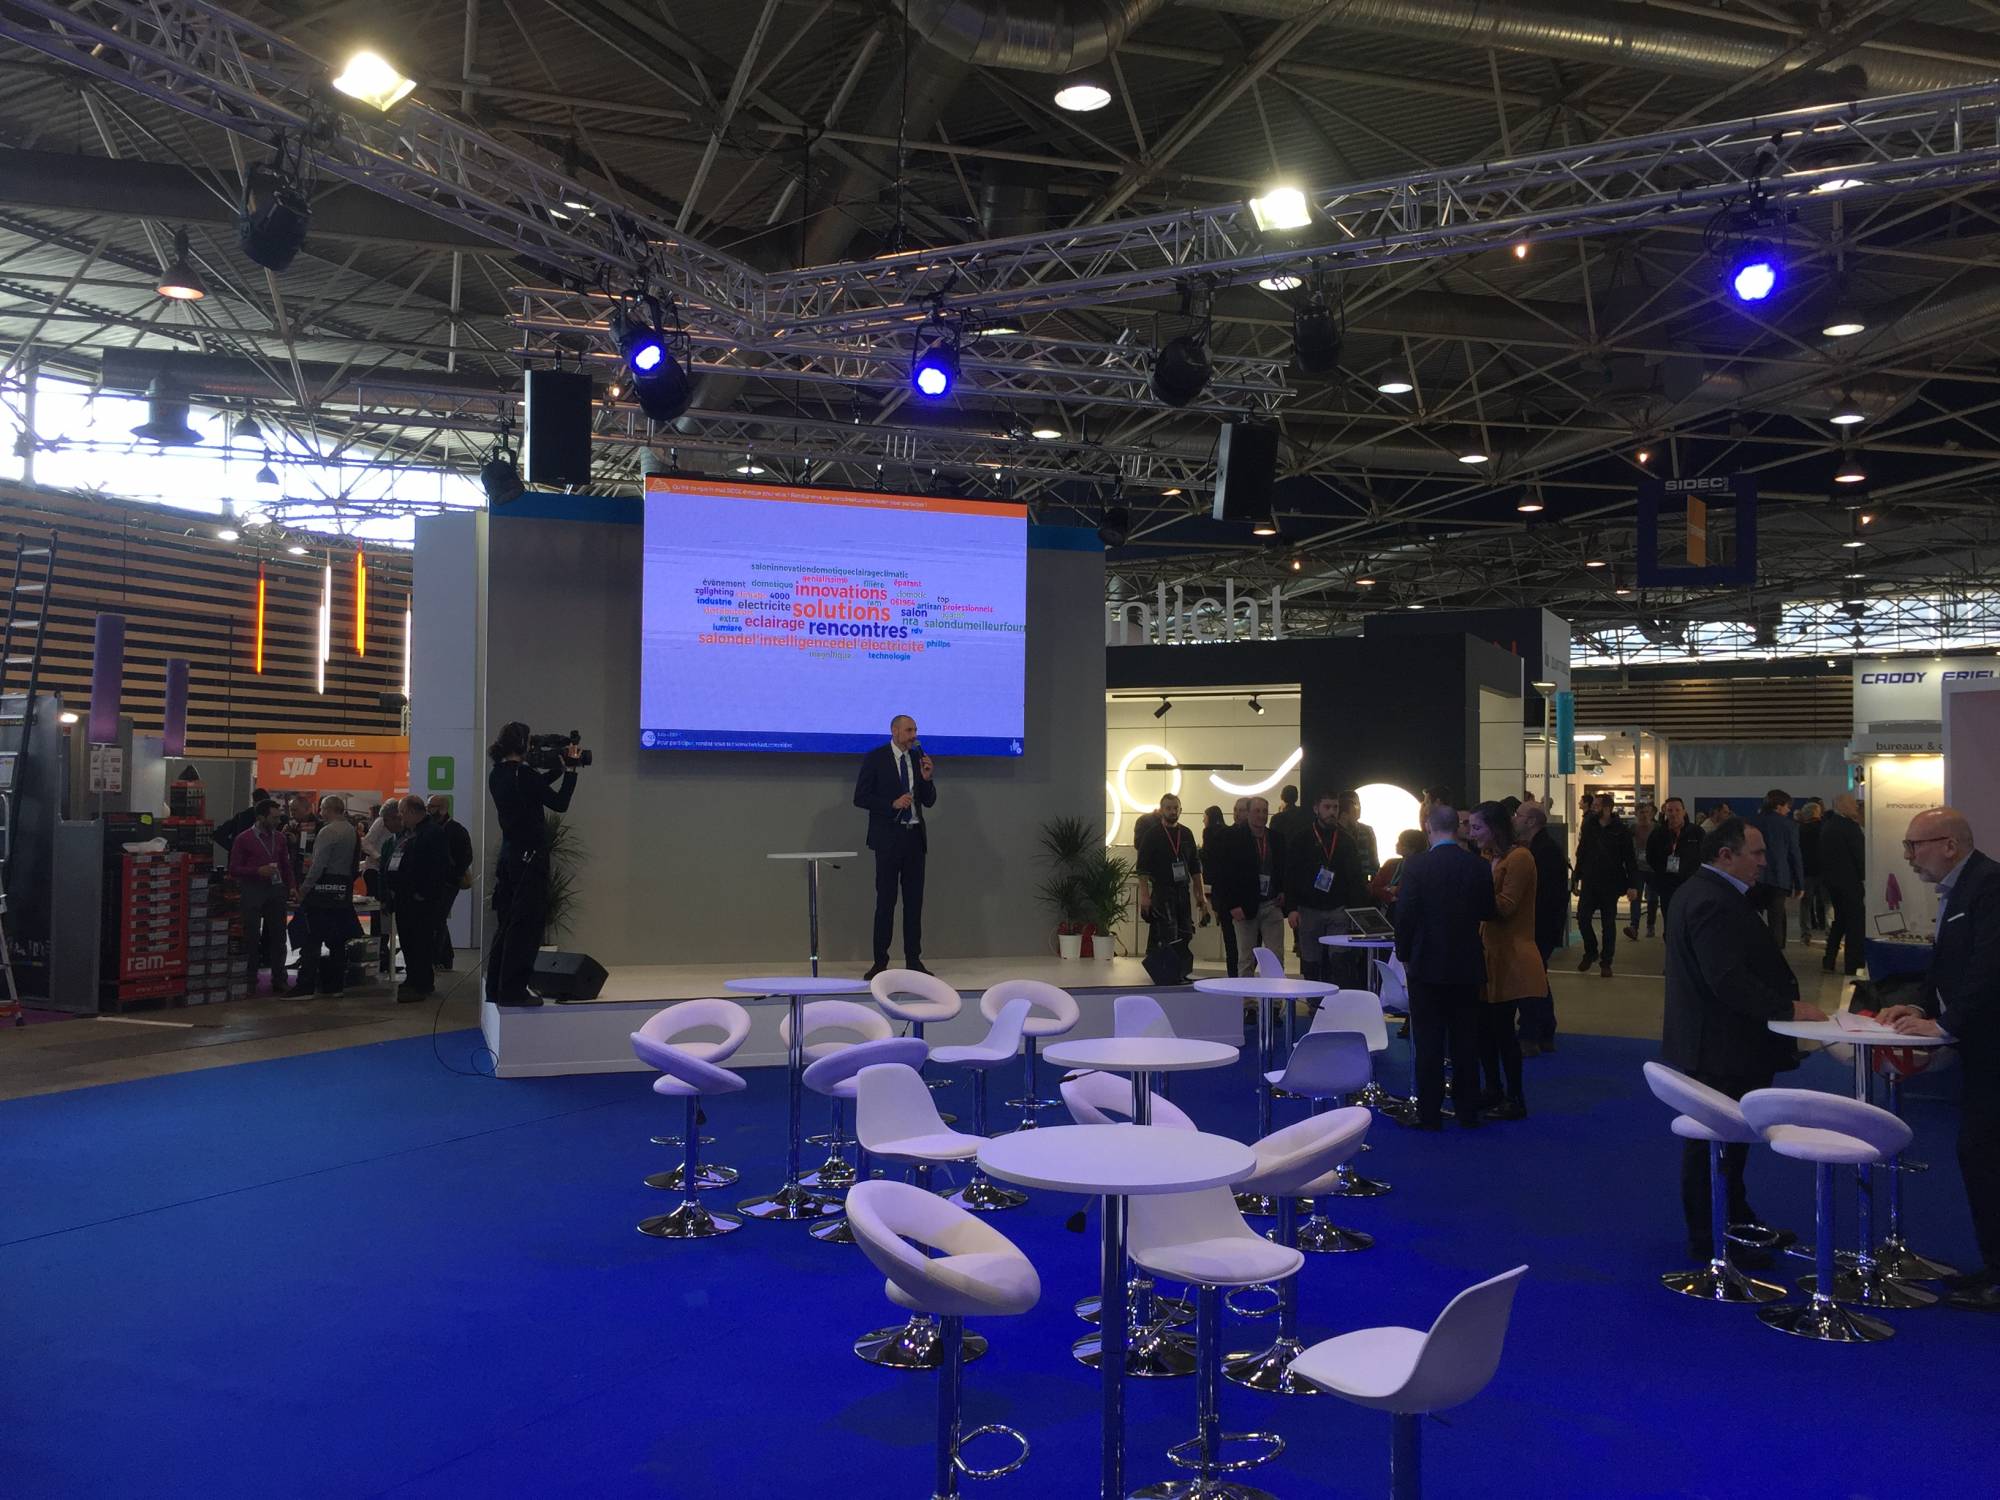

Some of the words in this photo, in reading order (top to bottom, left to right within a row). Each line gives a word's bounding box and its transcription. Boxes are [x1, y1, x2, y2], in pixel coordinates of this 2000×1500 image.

[1664, 478, 1723, 491] SIDEC
[769, 592, 790, 600] 4000
[795, 581, 887, 600] innovations
[738, 600, 791, 611] electricite
[917, 602, 942, 611] artisan
[936, 596, 949, 605] top
[793, 598, 890, 622] solutions
[901, 607, 928, 618] salon
[1105, 577, 1285, 646] nlicht
[745, 615, 805, 632] eclairage
[809, 621, 909, 639] rencontres
[924, 618, 1026, 632] salondumeilleurfour
[868, 652, 911, 662] technologie
[1861, 672, 1927, 685] CADDY
[297, 738, 356, 748] OUTILLAGE
[1876, 742, 1923, 751] bureaux
[1927, 742, 1936, 751] &
[280, 754, 323, 778] spit
[326, 758, 373, 769] BULL
[127, 954, 165, 972] ram
